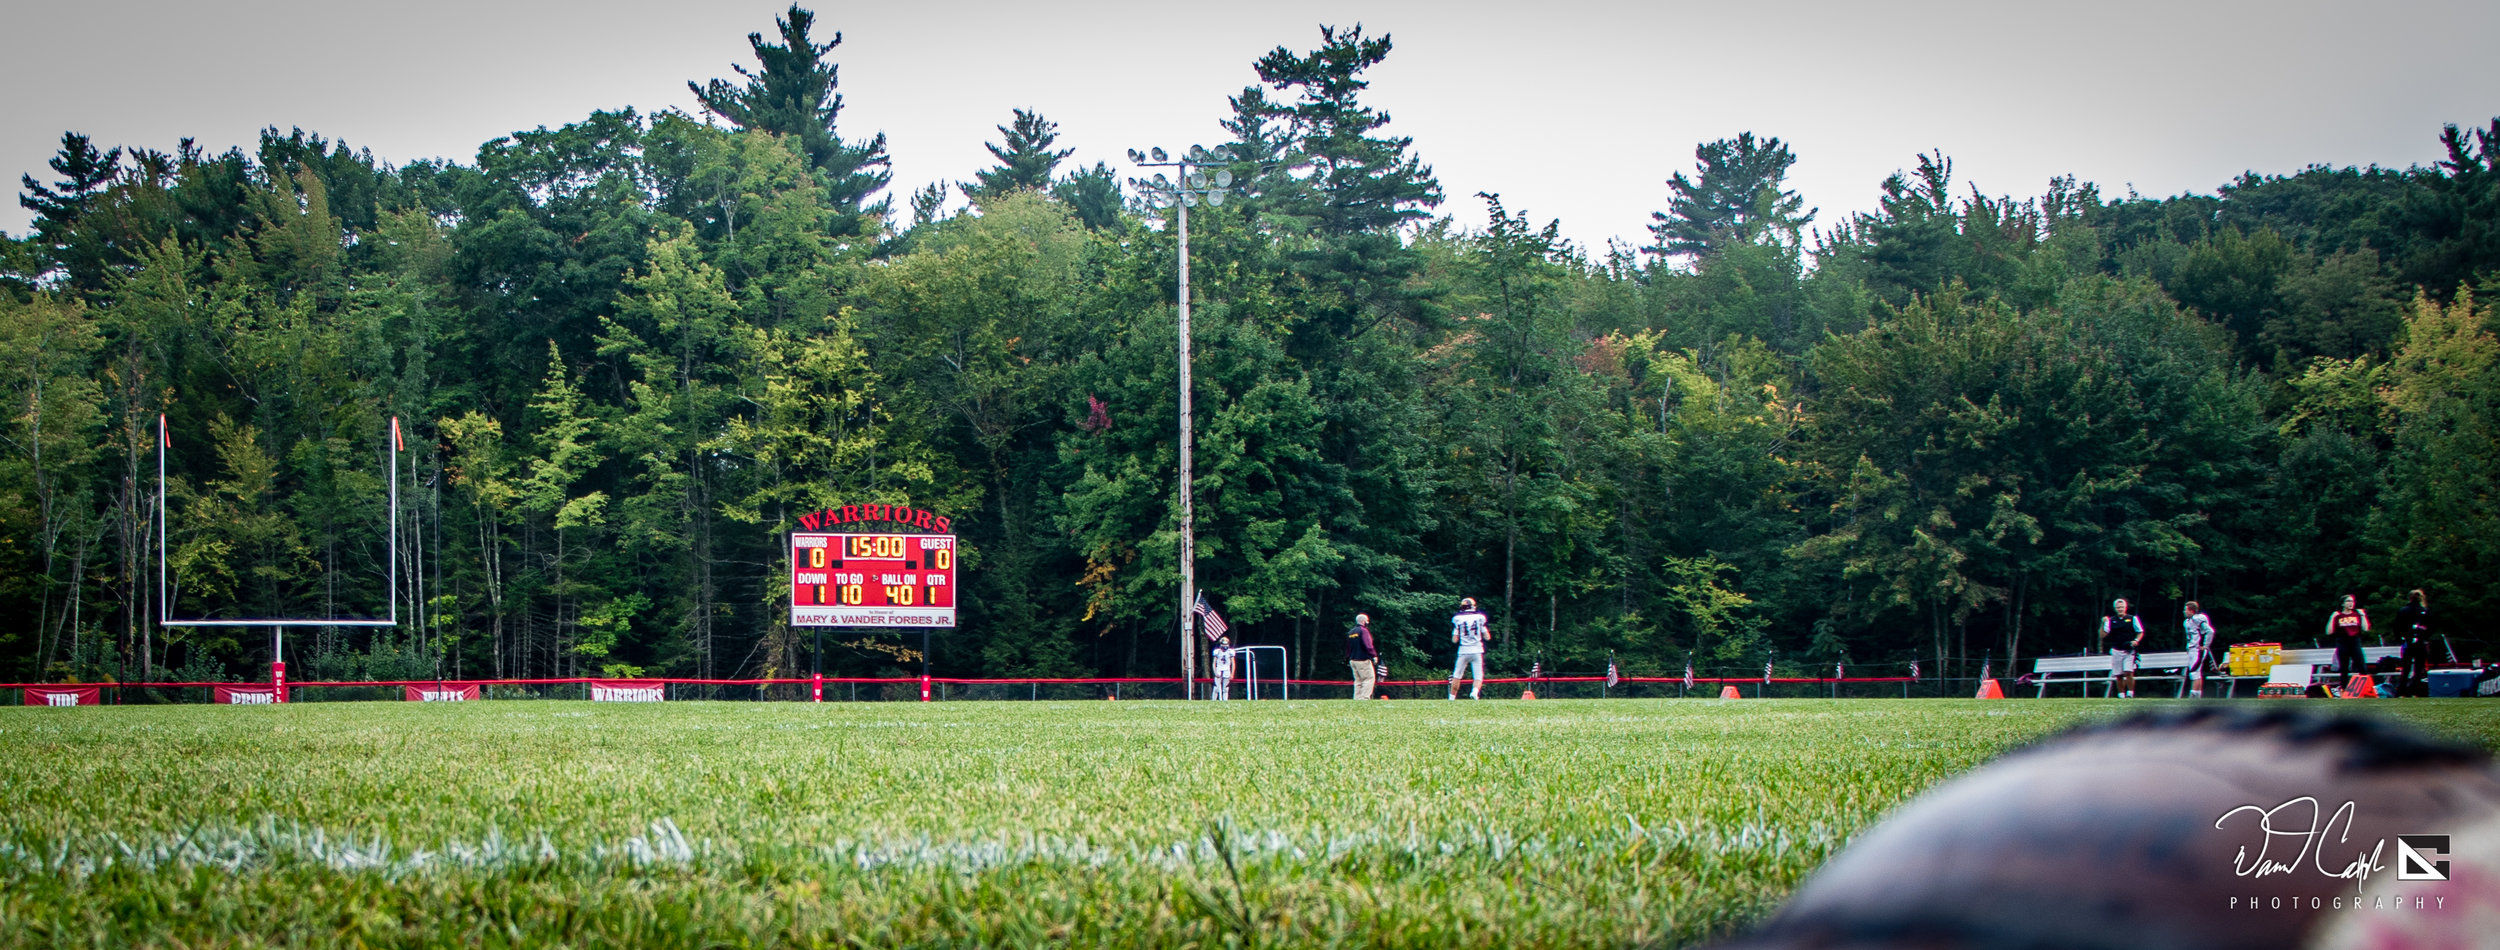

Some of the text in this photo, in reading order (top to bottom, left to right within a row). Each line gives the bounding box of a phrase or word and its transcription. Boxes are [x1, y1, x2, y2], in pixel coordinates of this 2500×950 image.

[799, 504, 950, 533] WARRIORS
[795, 537, 828, 548] WARRIORS
[851, 536, 904, 558] 15:00
[920, 538, 952, 550] GUEST
[812, 548, 825, 569] 0
[937, 549, 950, 570] 0
[798, 573, 827, 584] DOWN
[835, 573, 864, 585] TO GO
[881, 574, 917, 586] BALL ON
[927, 574, 946, 586] QTR
[819, 585, 825, 604] 1
[842, 584, 863, 605] 10
[886, 585, 913, 606] 40
[930, 586, 936, 605] 1
[796, 615, 952, 625] MARY & VANDER FORBES JR.
[1463, 620, 1479, 637] 14
[592, 687, 665, 702] WARRIORS
[2345, 676, 2368, 698] 40
